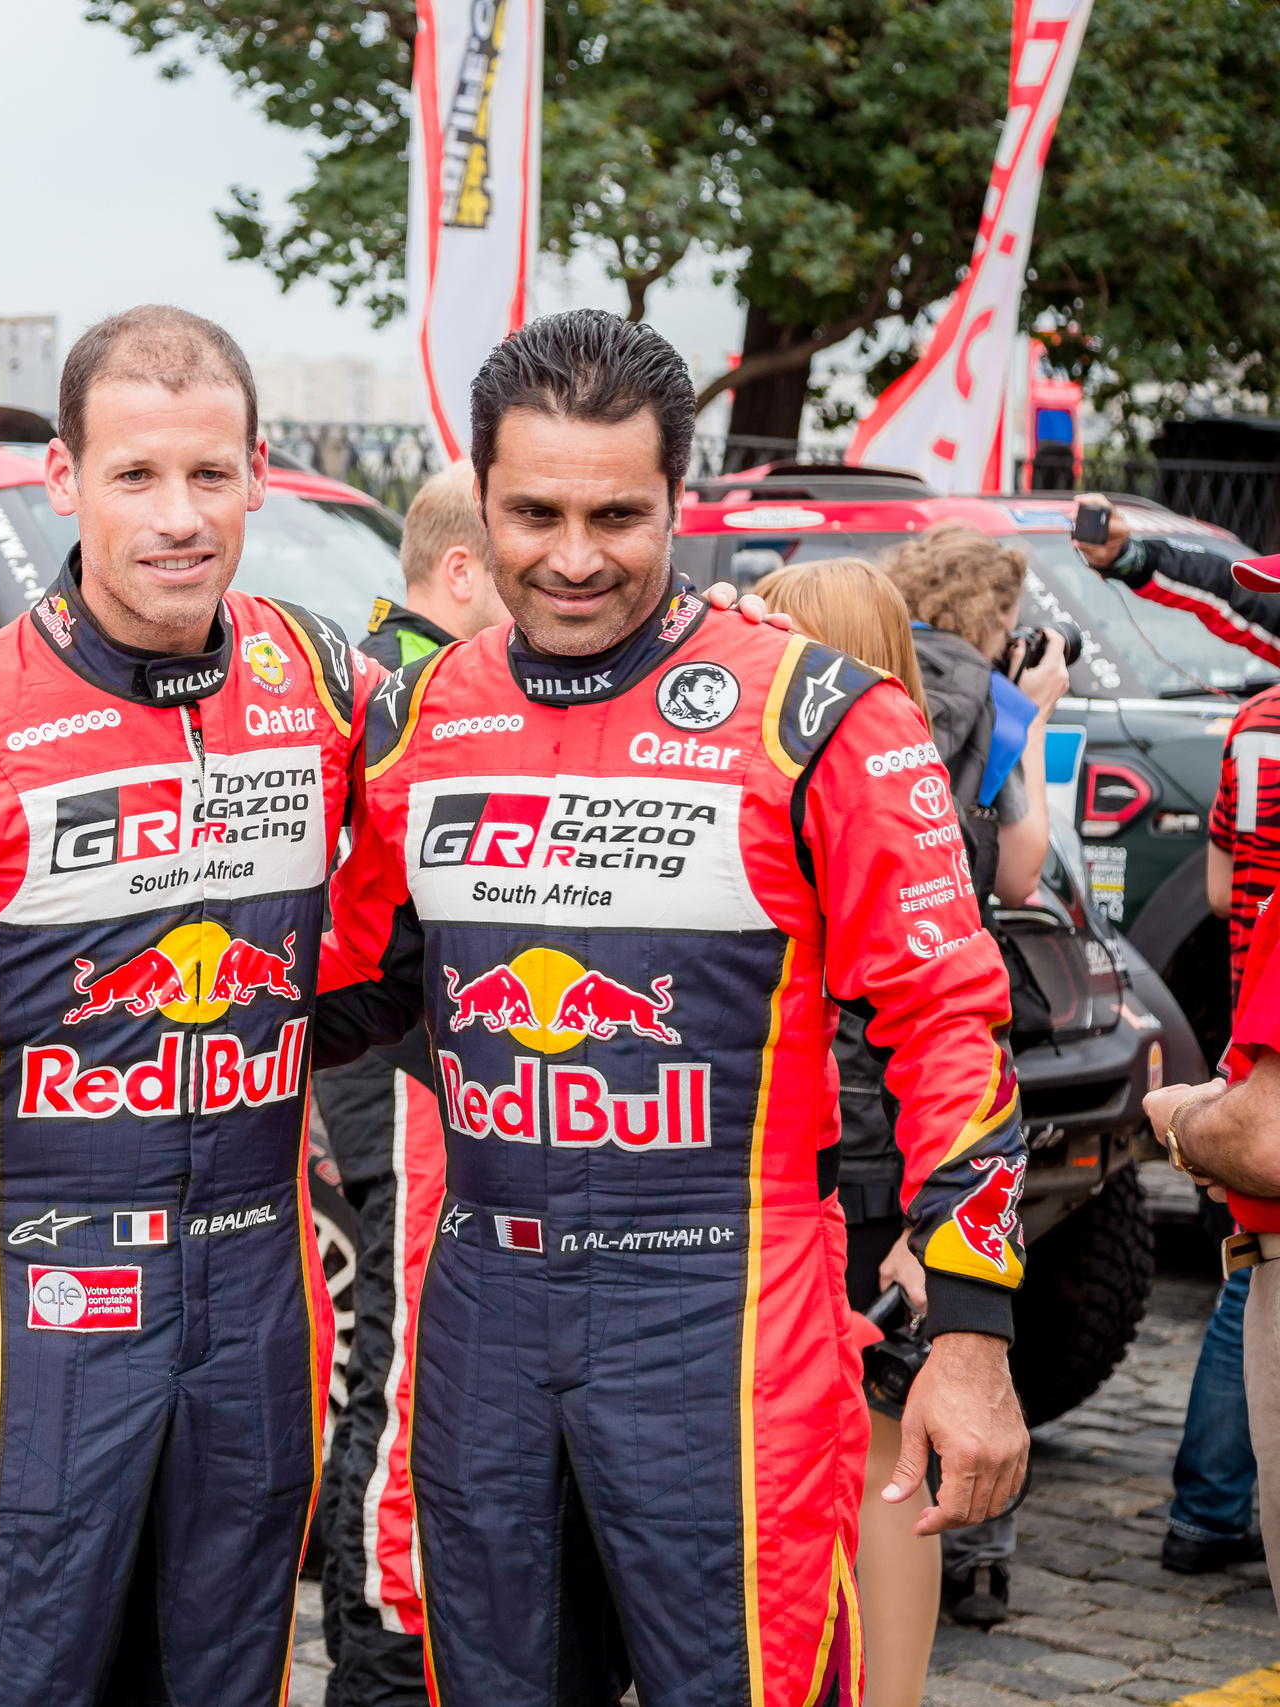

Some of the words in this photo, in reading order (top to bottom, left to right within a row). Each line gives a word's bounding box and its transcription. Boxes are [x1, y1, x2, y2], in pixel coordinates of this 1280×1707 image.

[35, 597, 59, 626] Red
[658, 617, 691, 642] Red
[677, 594, 704, 620] Bull
[46, 616, 72, 649] Bull
[523, 670, 613, 695] HILUX
[6, 707, 122, 752] ooredoo
[245, 704, 317, 736] Qatar
[431, 714, 525, 741] ooredoo
[628, 731, 741, 771] Qatar
[209, 768, 317, 795] TOYOTA
[205, 793, 310, 820] GAZOO
[557, 793, 717, 825] TOYOTA
[53, 803, 180, 871] GR
[204, 817, 307, 844] Racing
[421, 812, 540, 867] GR
[549, 819, 696, 847] GAZOO
[542, 844, 687, 879] Racing
[129, 868, 190, 895] South
[203, 860, 255, 880] Africa
[899, 875, 955, 900] FINANCIAL
[472, 881, 537, 906] South
[542, 884, 613, 907] Africa
[900, 888, 956, 913] SERVICES
[17, 1031, 185, 1119] Red
[200, 1015, 309, 1116] Bull
[438, 1050, 542, 1145] Red
[548, 1063, 713, 1153] Bull
[209, 1204, 278, 1234] BAUMEL
[584, 1228, 703, 1250] AL-ATTIYAH
[85, 1286, 109, 1296] Votre
[110, 1286, 138, 1298] expert
[88, 1295, 133, 1306] comptable
[87, 1305, 132, 1316] partenaire
